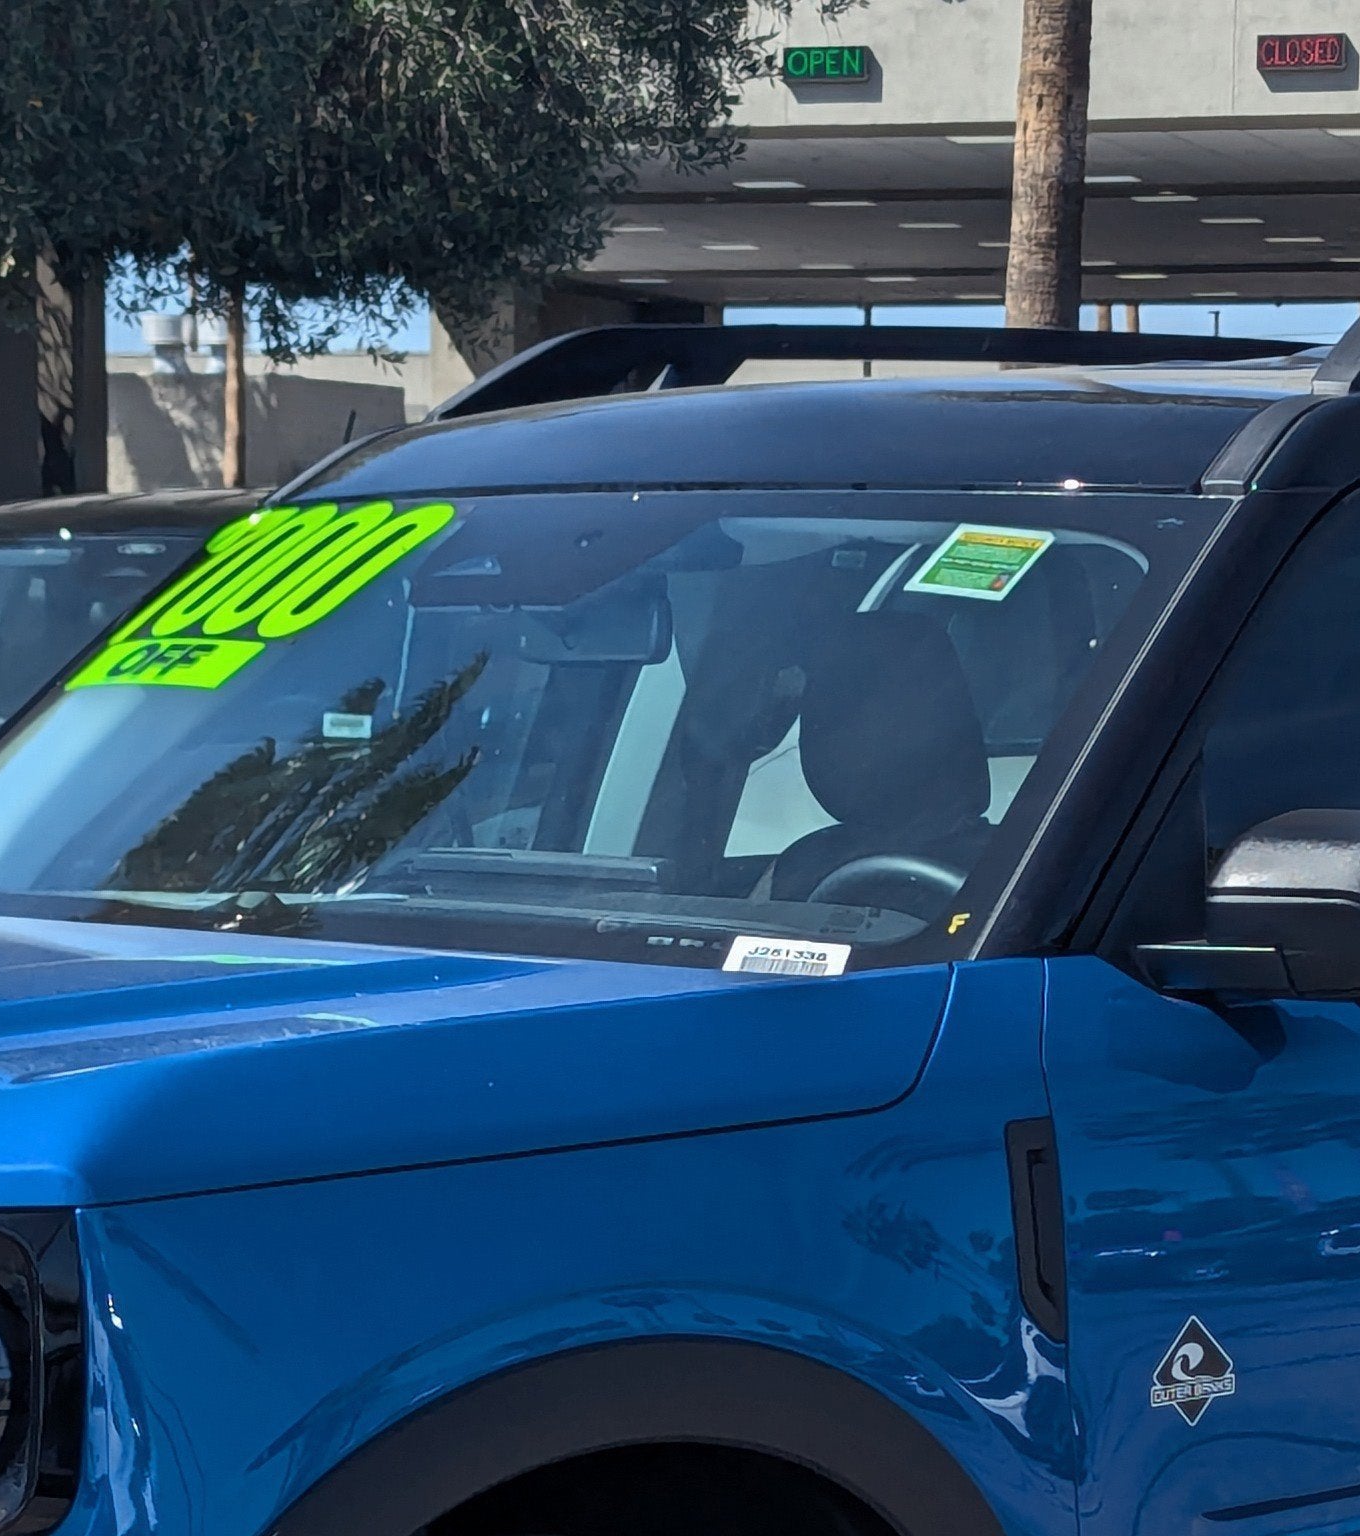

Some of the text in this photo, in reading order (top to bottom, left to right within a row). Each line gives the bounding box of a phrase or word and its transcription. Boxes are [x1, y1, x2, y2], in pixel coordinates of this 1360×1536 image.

[787, 49, 861, 76] OPEN
[1261, 38, 1340, 65] CLOSED
[106, 642, 219, 680] OFF
